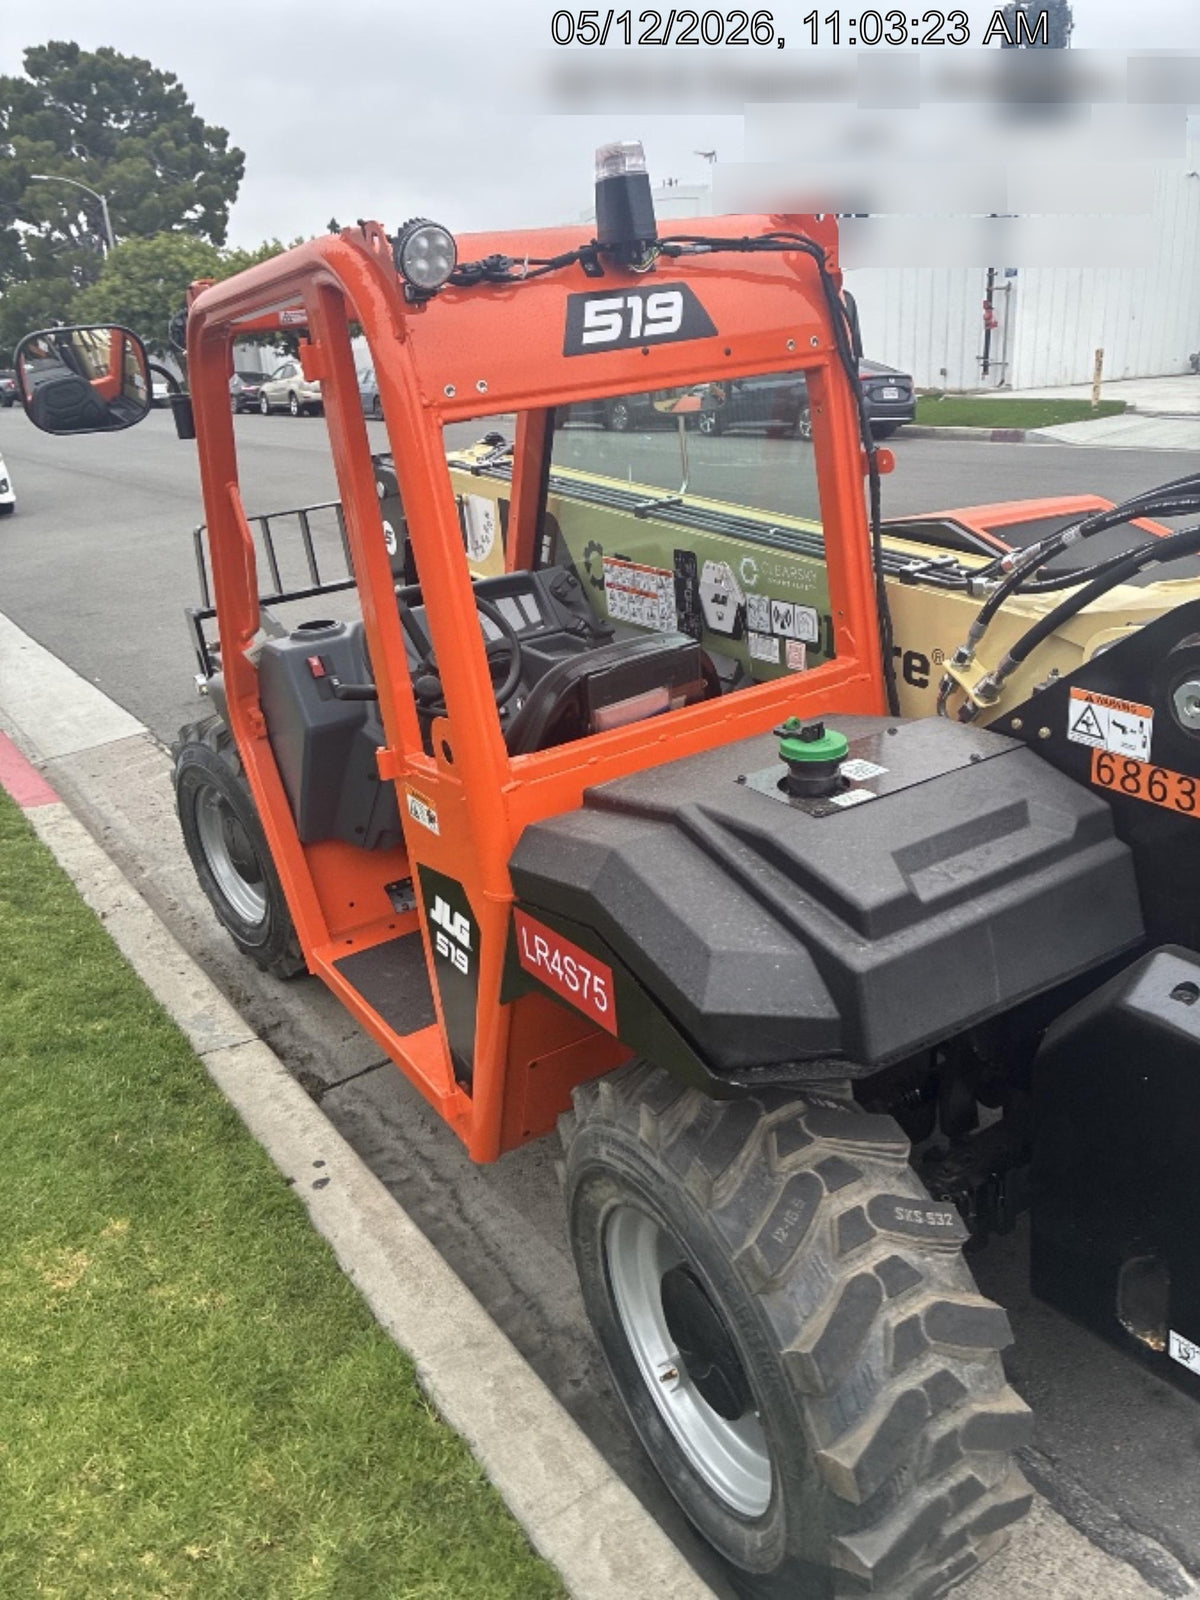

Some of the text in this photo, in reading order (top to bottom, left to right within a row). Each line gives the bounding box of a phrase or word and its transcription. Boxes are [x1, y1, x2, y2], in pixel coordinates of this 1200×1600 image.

[582, 290, 683, 345] 519
[1096, 752, 1196, 812] 6863
[430, 895, 471, 949] JLG
[436, 931, 469, 976] 519
[521, 926, 608, 1013] LR4S75
